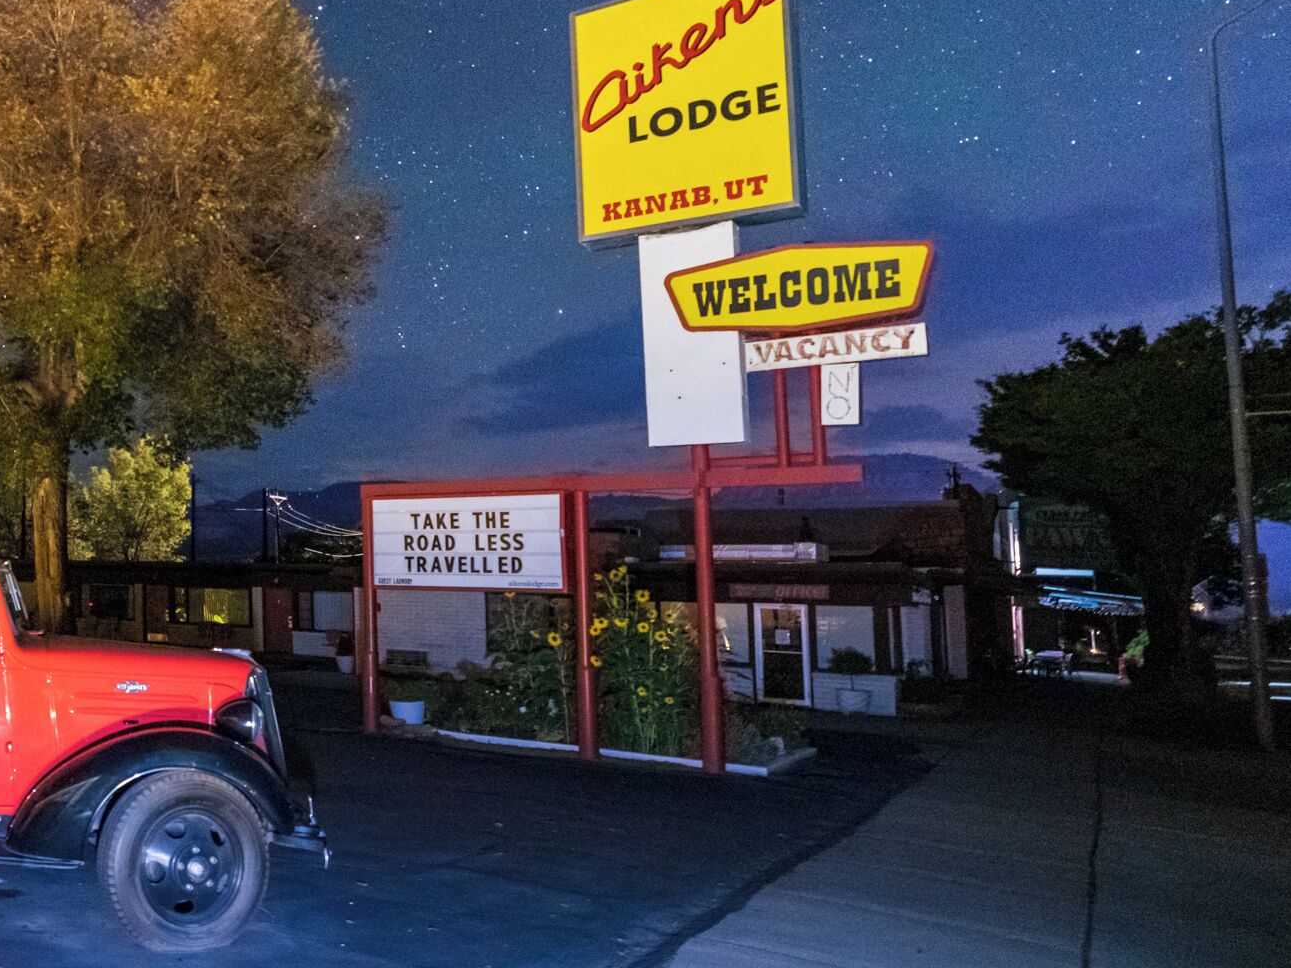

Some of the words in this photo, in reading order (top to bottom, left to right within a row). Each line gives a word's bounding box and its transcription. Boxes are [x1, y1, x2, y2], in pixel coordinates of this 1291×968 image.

[629, 82, 781, 144] LODGE
[602, 185, 719, 223] KANAB,
[723, 174, 769, 201] UT
[692, 258, 901, 317] WELCOME
[753, 327, 915, 364] VACANCY
[410, 512, 461, 530] TAKE
[472, 511, 511, 529] THE
[403, 534, 456, 552] ROAD
[474, 533, 525, 551] LESS
[404, 555, 524, 574] TRAVELLED
